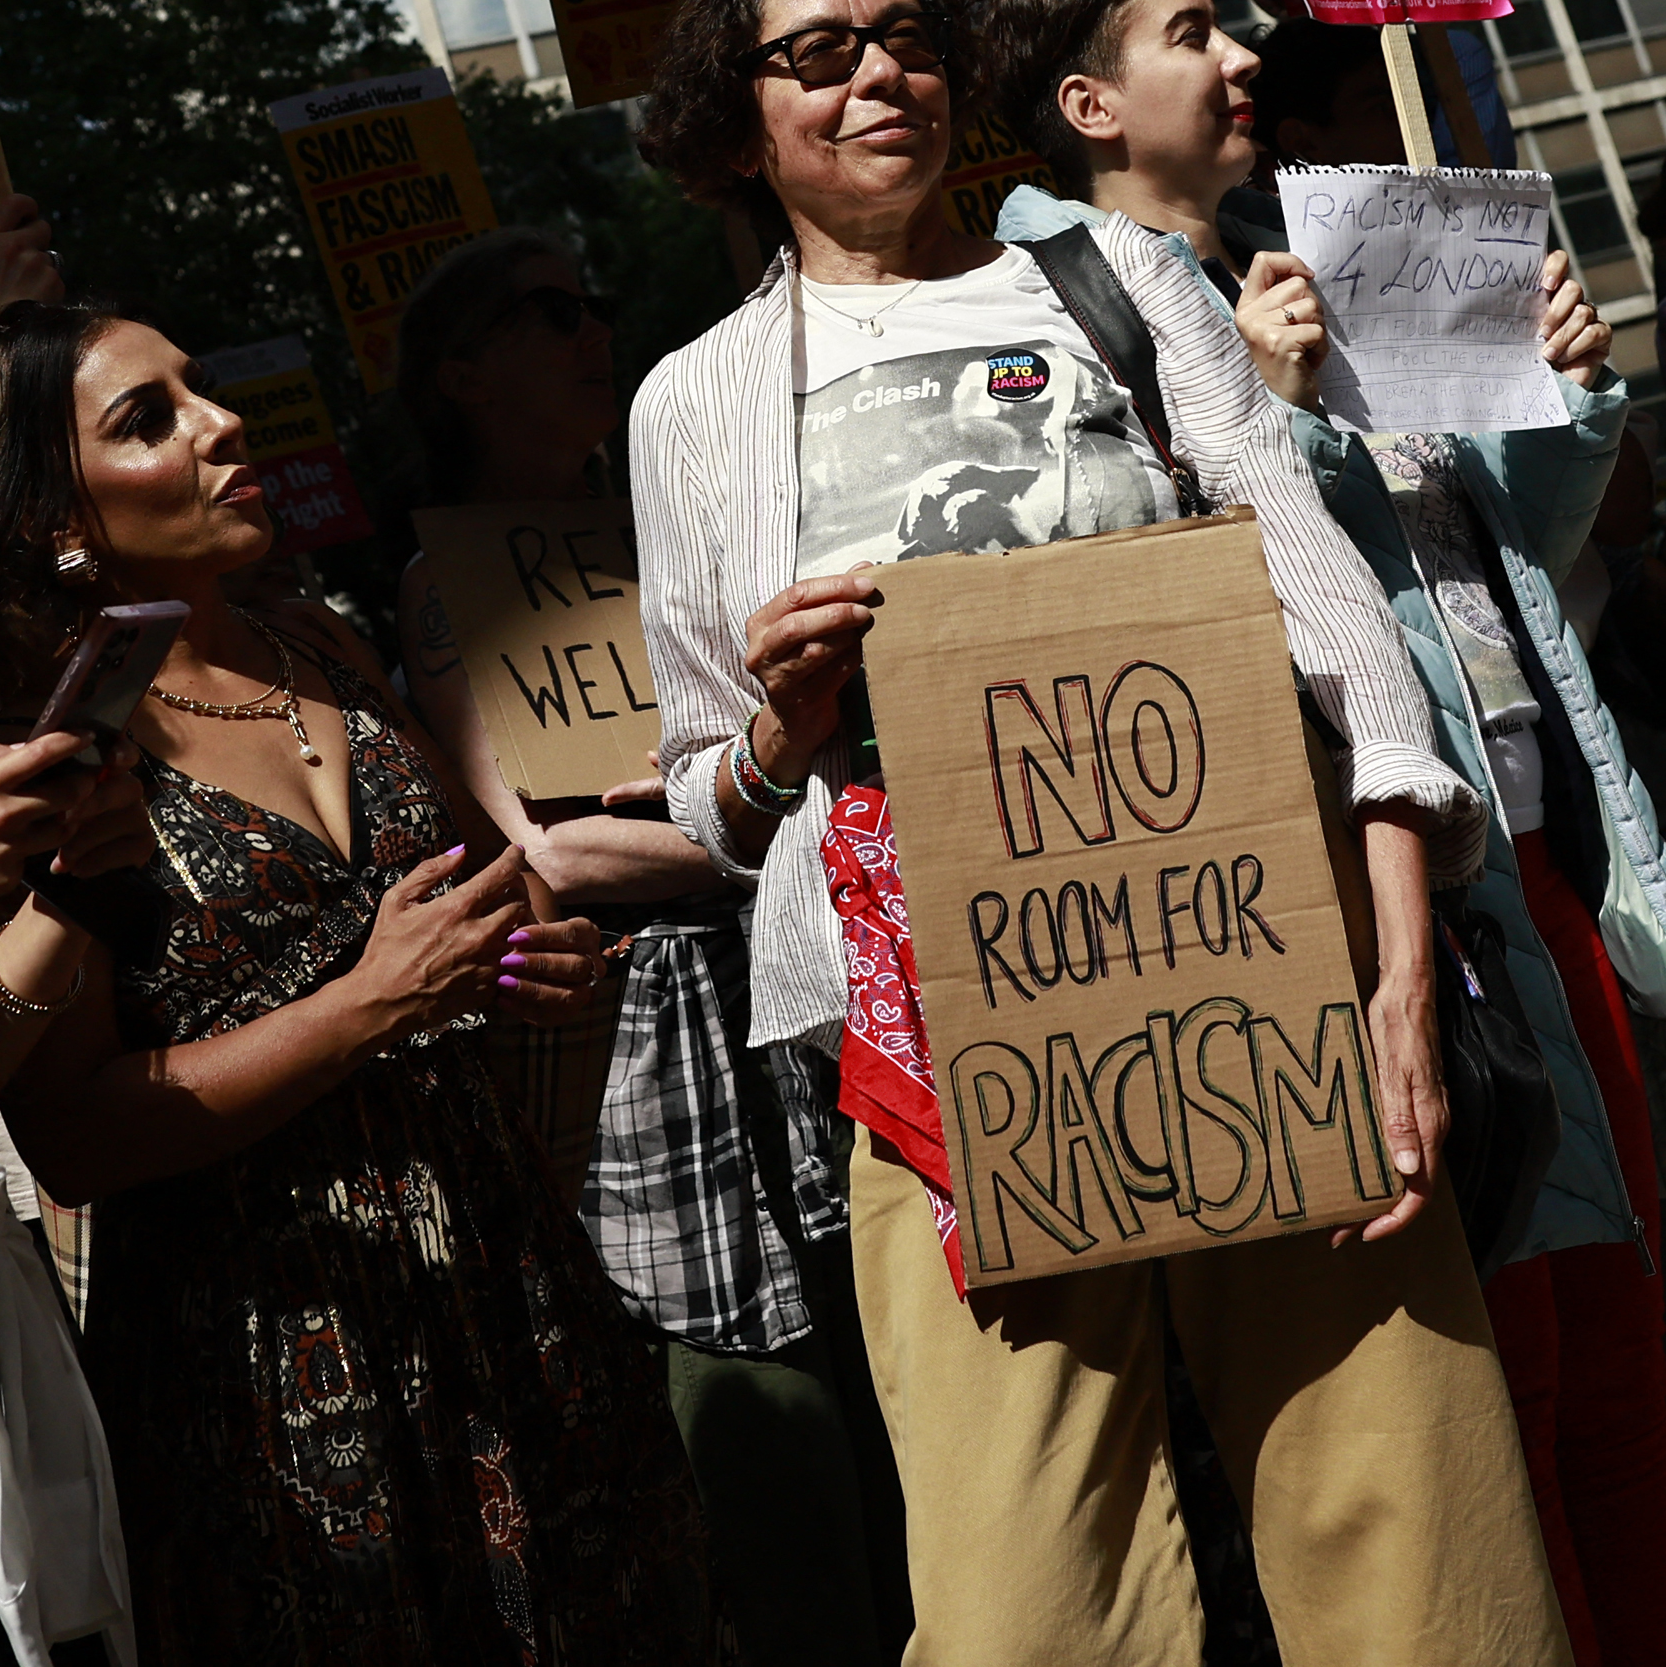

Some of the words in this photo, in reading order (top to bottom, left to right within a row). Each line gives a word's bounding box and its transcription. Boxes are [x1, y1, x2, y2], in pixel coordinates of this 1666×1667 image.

[295, 115, 418, 185] SMASH
[315, 172, 463, 249] FASCISM
[1478, 198, 1545, 239] NOT
[1331, 240, 1367, 308] 4
[987, 355, 1034, 370] STAND
[1011, 366, 1033, 377] TO
[1441, 350, 1469, 365] THE
[852, 377, 941, 414] Clash
[990, 374, 1045, 391] RACISM
[283, 459, 333, 490] the
[982, 658, 1207, 861] NO
[968, 872, 1144, 1010] ROOM
[1156, 853, 1286, 972] FOR
[949, 994, 1396, 1274] RACISM
